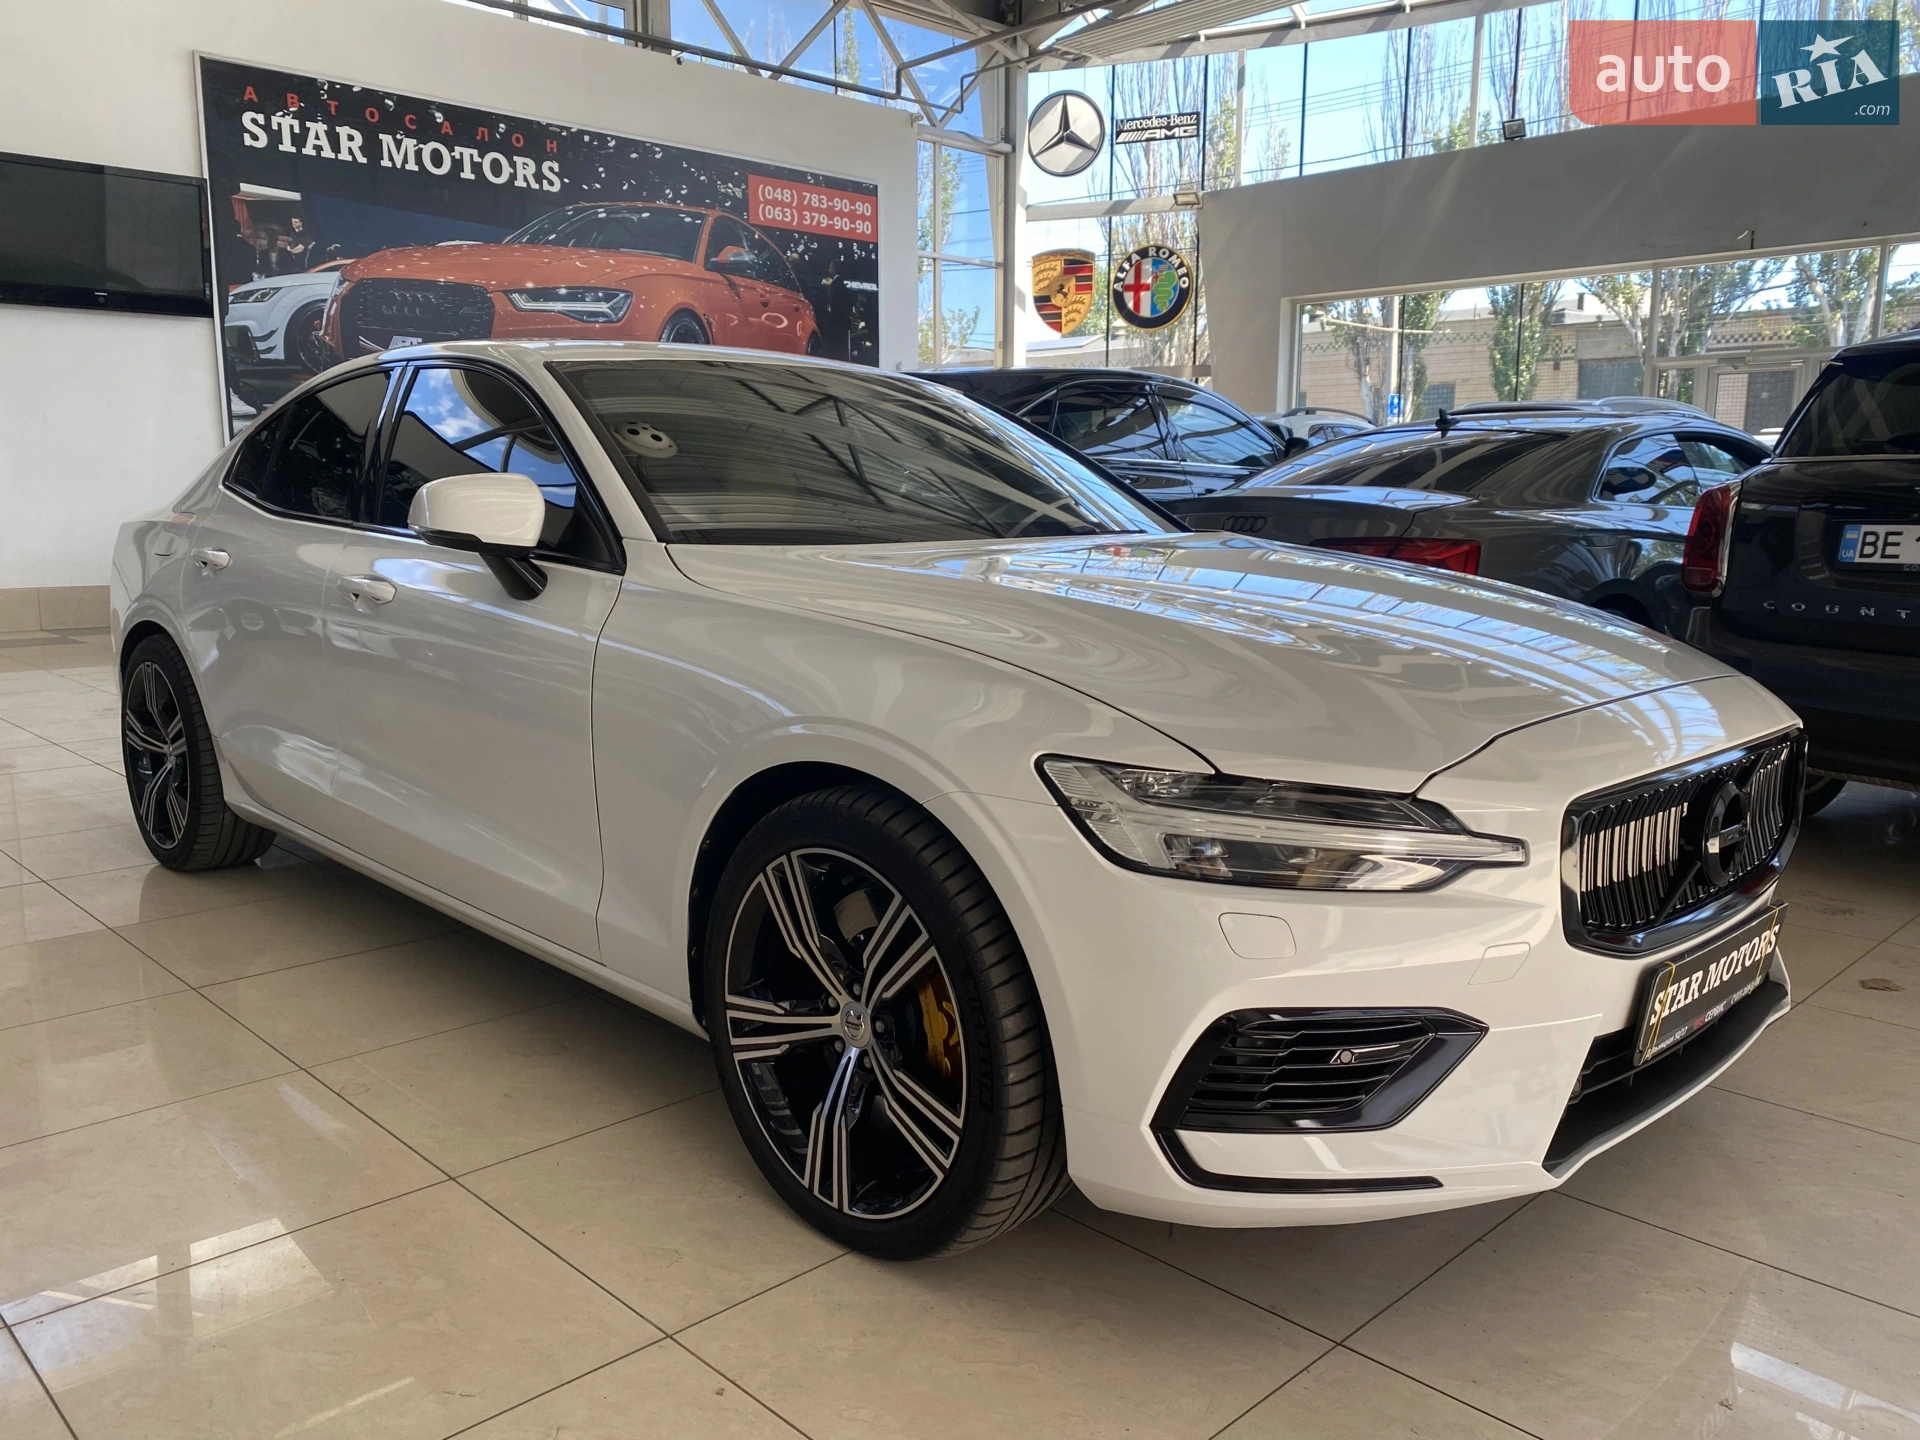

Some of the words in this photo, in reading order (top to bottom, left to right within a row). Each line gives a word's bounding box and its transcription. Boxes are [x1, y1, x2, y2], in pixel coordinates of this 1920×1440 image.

[242, 85, 558, 154] АВТОСАЛОН
[1116, 114, 1198, 131] Mercedes-Benz
[1141, 125, 1198, 140] AMG
[241, 111, 367, 164] STAR
[378, 133, 562, 193] MOTORS
[758, 184, 798, 207] (048)
[802, 192, 872, 216] 783-90-90
[758, 203, 798, 226] (063)
[802, 211, 872, 235] 379-90-90
[1113, 252, 1142, 293] ALFA
[1148, 246, 1190, 289] ROMEO
[1841, 549, 1854, 558] UA
[1859, 530, 1904, 559] BE
[1649, 970, 1704, 1026] STAR
[1702, 924, 1780, 995] MOTORS
